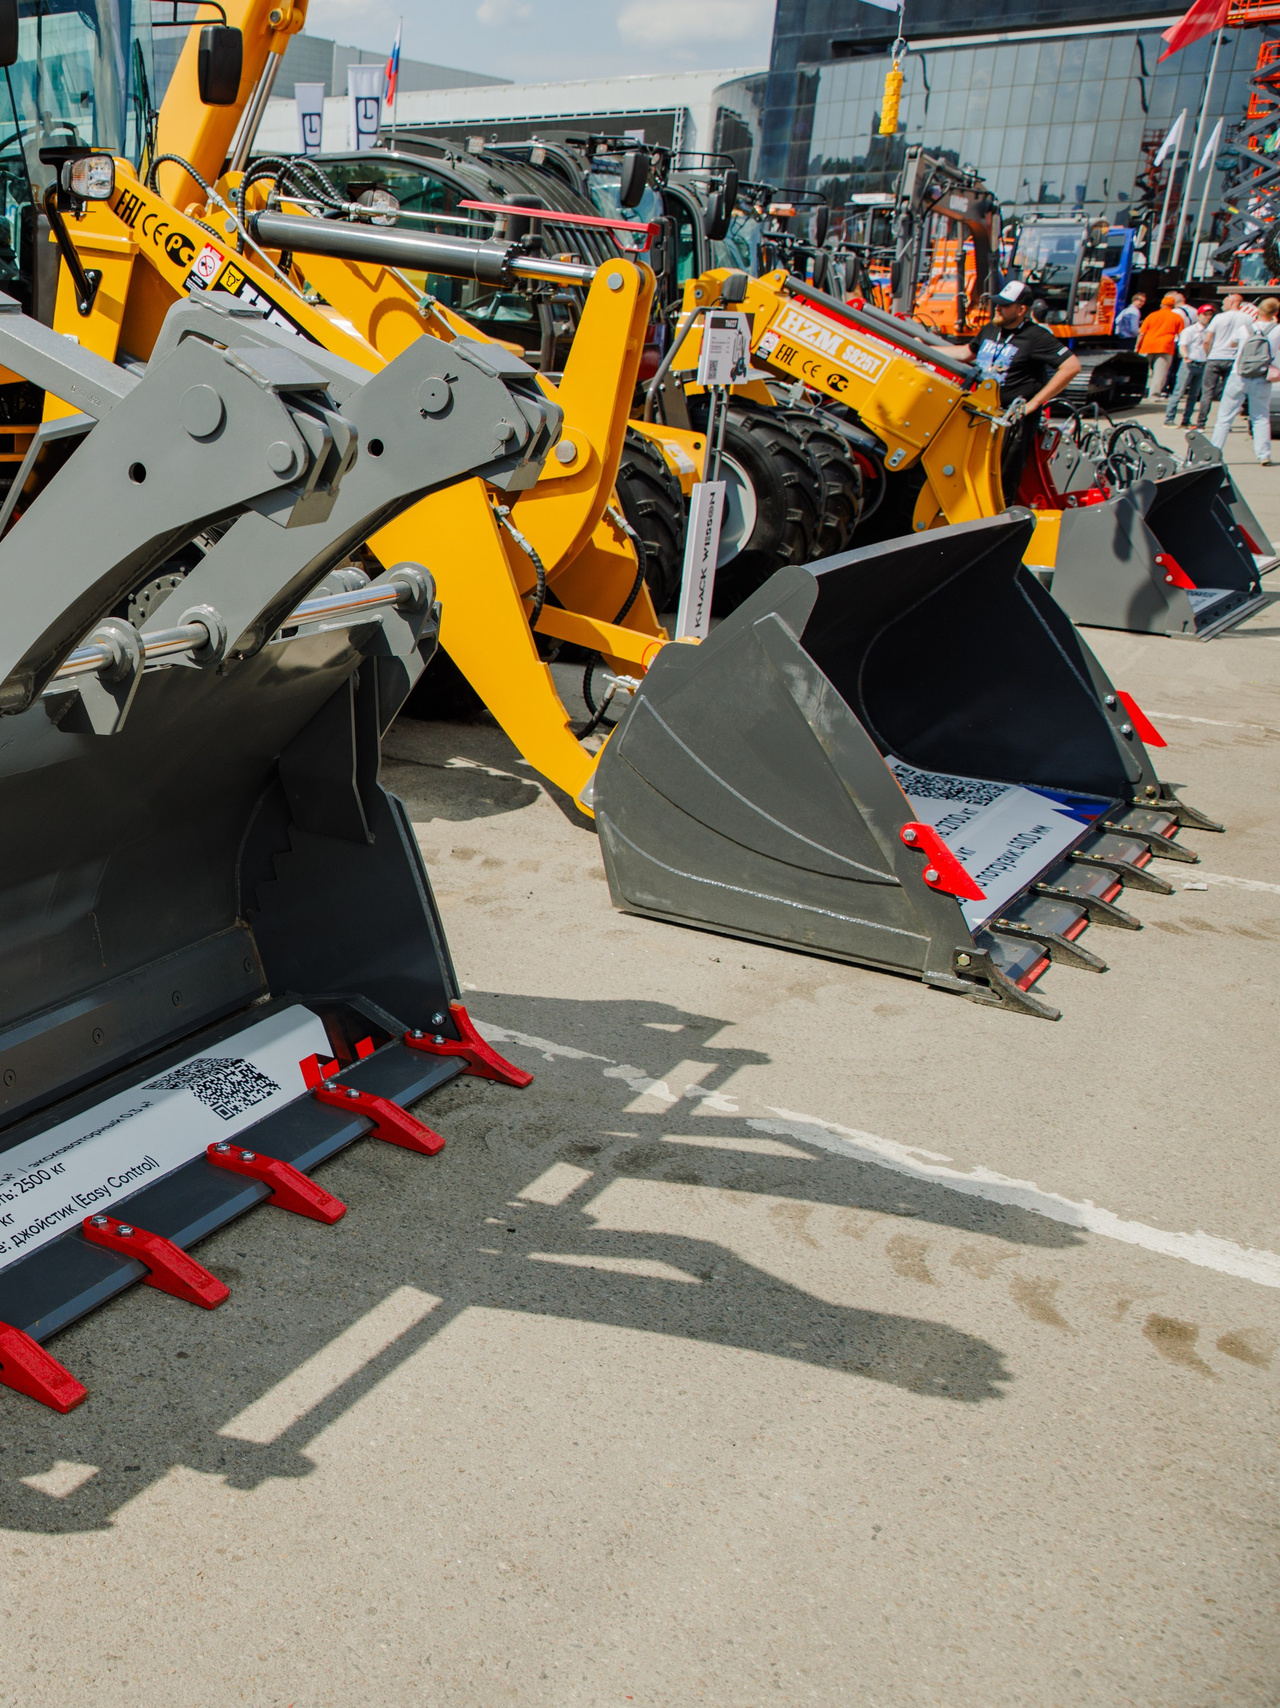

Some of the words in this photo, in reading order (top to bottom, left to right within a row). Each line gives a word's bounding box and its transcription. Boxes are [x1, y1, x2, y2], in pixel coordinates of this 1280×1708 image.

[780, 310, 845, 357] HZM
[842, 344, 882, 375] S825T
[695, 567, 707, 628] KNACK
[702, 492, 715, 562] WESSON
[935, 813, 971, 830] 2700
[975, 848, 1025, 881] погрузки:
[1006, 832, 1042, 850] 4100
[1029, 824, 1053, 836] мм
[10, 1203, 79, 1248] джойстик
[71, 1184, 112, 1209] (Easy
[107, 1154, 161, 1189] Control)
[13, 1169, 52, 1194] 2500
[50, 1162, 66, 1176] кг
